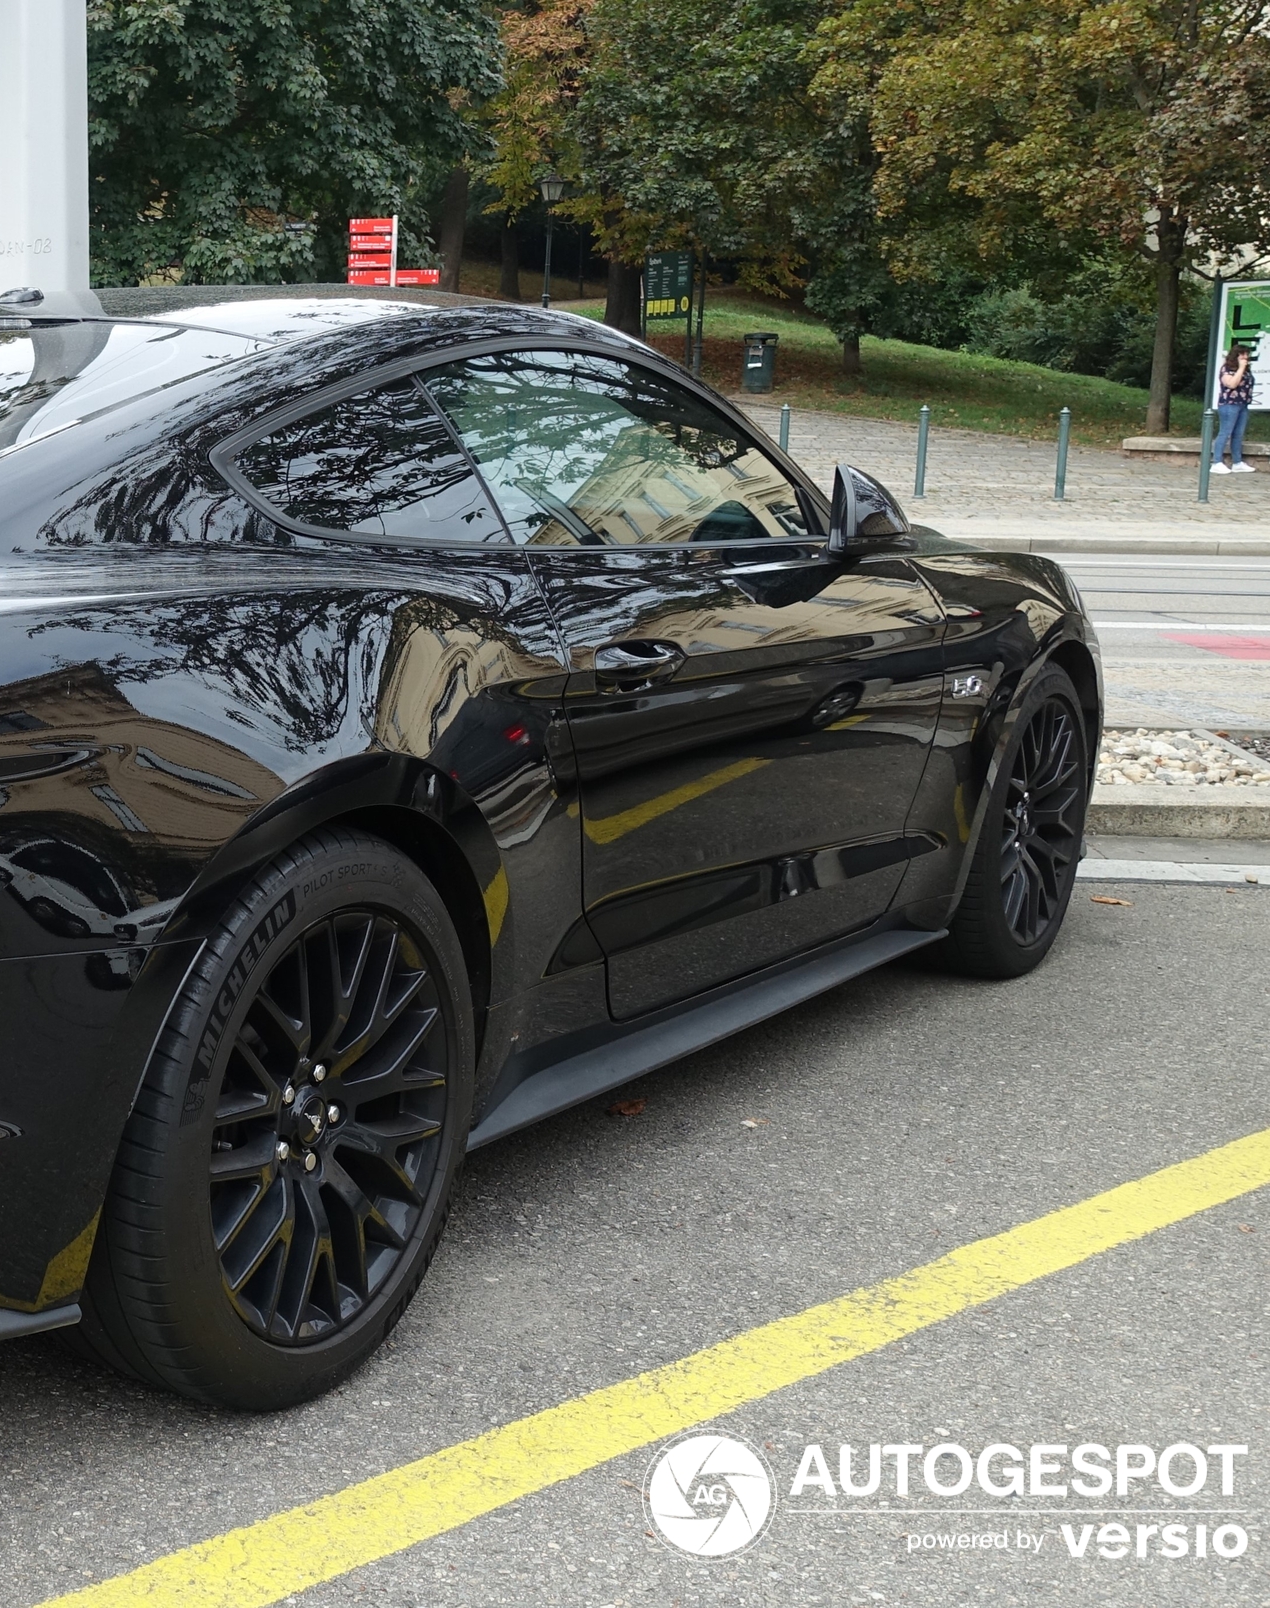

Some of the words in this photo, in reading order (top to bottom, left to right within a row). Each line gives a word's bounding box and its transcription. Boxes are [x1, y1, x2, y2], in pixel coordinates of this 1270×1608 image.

[303, 869, 334, 898] PILOT
[338, 863, 372, 879] SPORT
[197, 899, 290, 1069] MICHELIN
